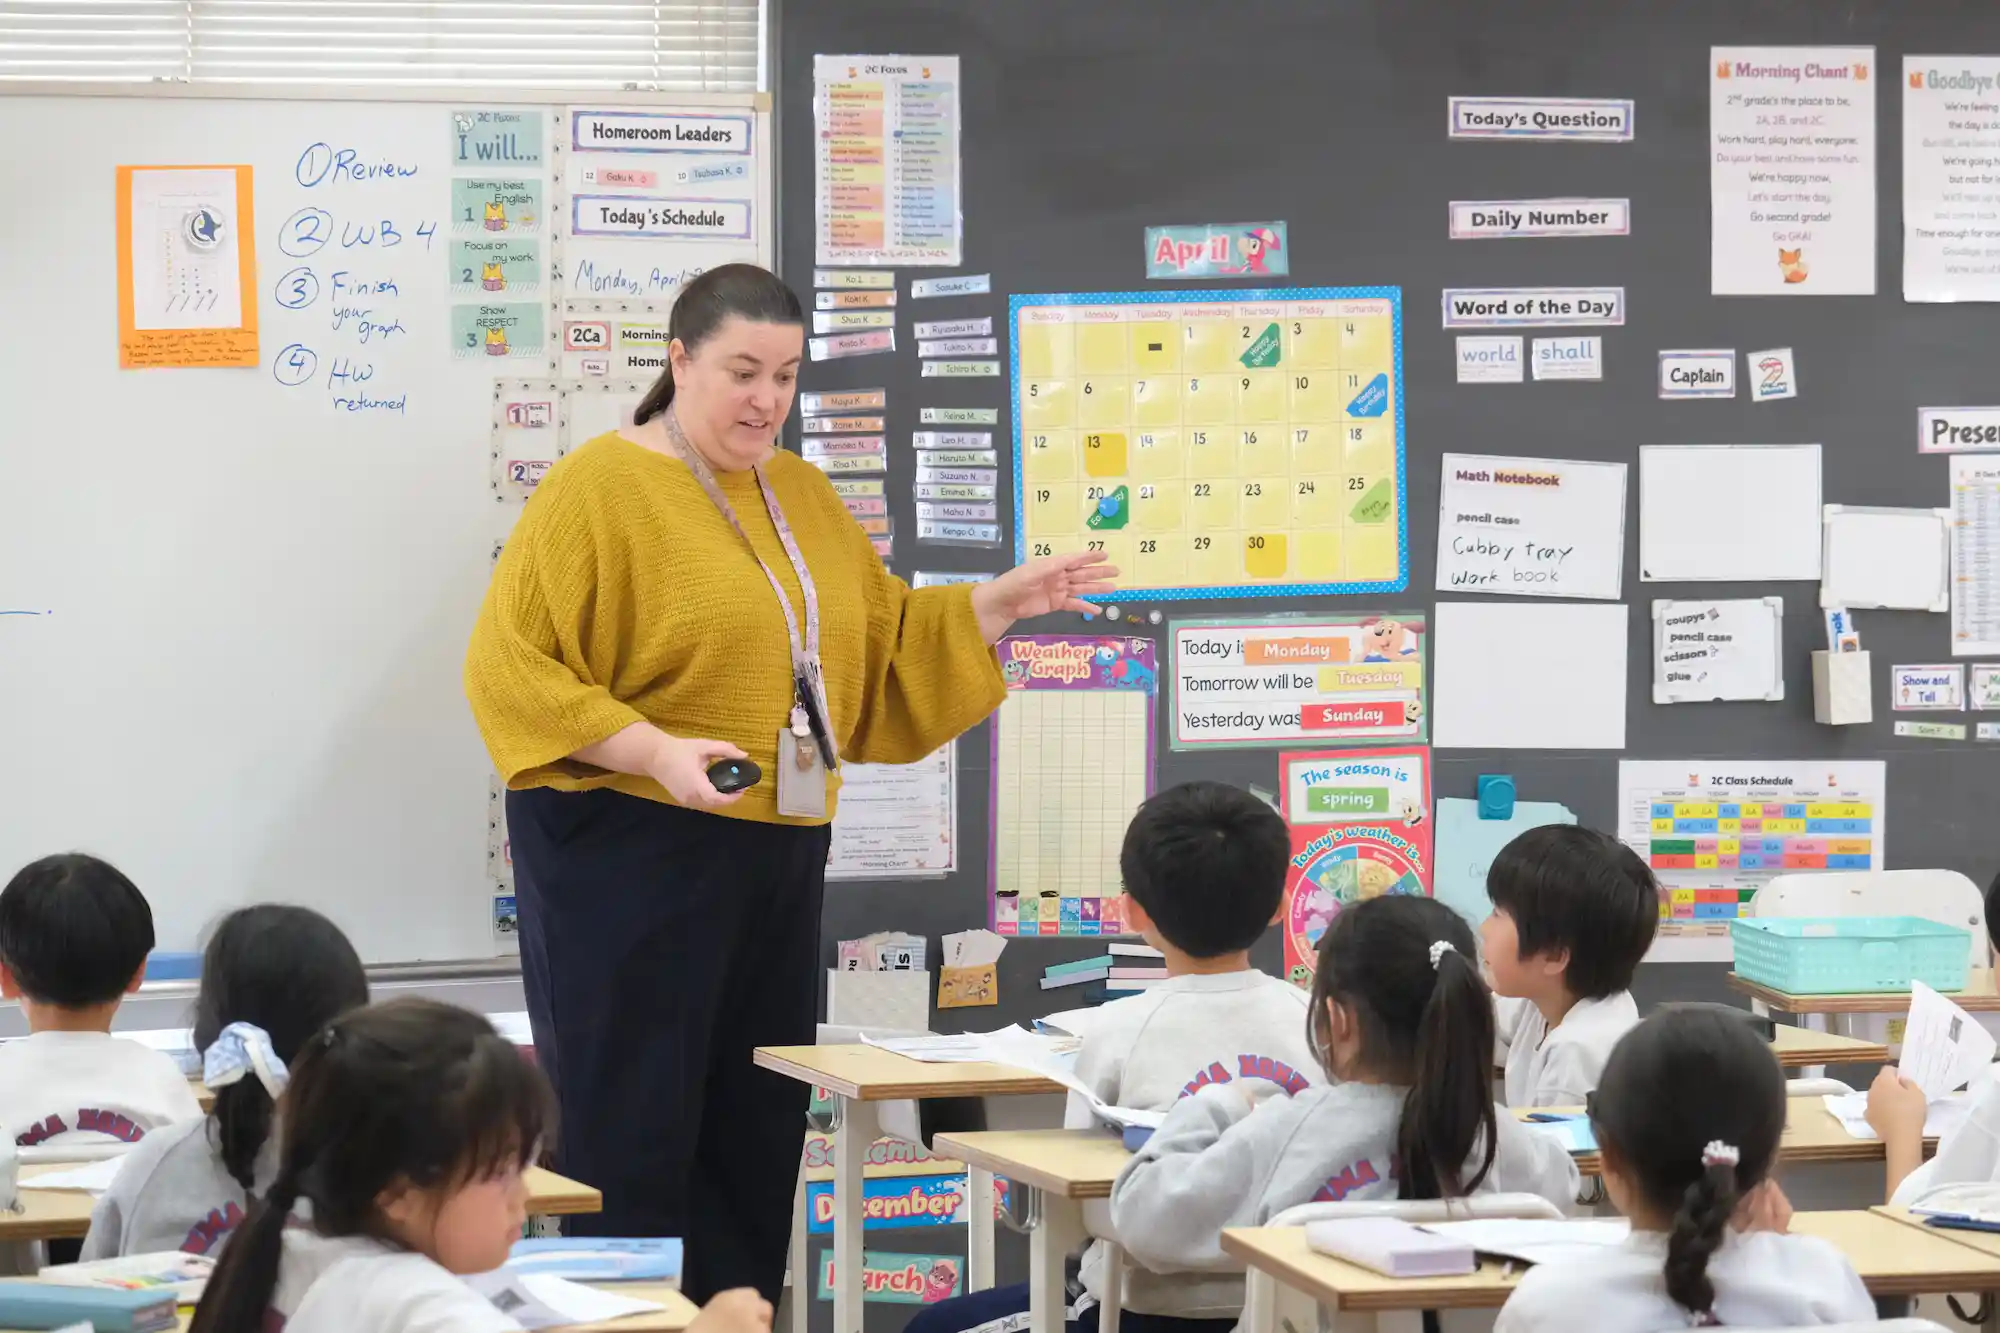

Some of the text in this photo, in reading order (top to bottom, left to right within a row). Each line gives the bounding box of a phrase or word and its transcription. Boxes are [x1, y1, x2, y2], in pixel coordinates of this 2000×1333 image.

[1736, 62, 1849, 84] Morning Chant
[1781, 94, 1797, 106] the
[1798, 94, 1824, 108] place
[1825, 95, 1835, 106] to
[1464, 110, 1622, 131] Today's Question
[592, 122, 732, 142] Homeroom Leaders
[458, 135, 468, 160] I
[333, 148, 418, 185] Review
[466, 180, 524, 192] Use my best
[494, 193, 534, 206] English
[465, 208, 474, 222] 1
[662, 208, 726, 226] Schedule
[1471, 209, 1610, 230] Daily Number
[341, 220, 402, 249] WB
[416, 222, 438, 250] 4
[464, 242, 494, 250] Focus
[1154, 236, 1230, 271] April
[492, 253, 534, 265] my work
[462, 269, 474, 282] 2
[574, 259, 686, 296] Monday, April
[331, 271, 400, 302] Finish
[480, 306, 506, 316] Show
[1454, 298, 1615, 318] Word of the Day
[332, 306, 373, 331] your
[476, 318, 518, 328] RESPECT
[358, 320, 406, 344] graph
[466, 333, 478, 347] 3
[573, 328, 600, 344] 2Ca
[622, 329, 670, 342] Morning
[1242, 326, 1251, 338] 2
[1294, 322, 1302, 335] 3
[1346, 322, 1354, 334] 4
[1462, 340, 1594, 362] world shall
[328, 358, 373, 390] HW
[1670, 356, 1788, 397] Captain 2
[1030, 375, 1358, 398] 5 6 7 8 9 10 11
[332, 391, 406, 415] returned
[512, 408, 520, 424] 1
[1033, 428, 1362, 449] 12 13 14 15 16 17 18
[1932, 418, 2000, 446] Prese
[514, 464, 525, 482] 2
[1456, 470, 1560, 487] Math Notebook
[1036, 478, 1364, 504] 19 20 21 22 23 24 25
[1456, 511, 1520, 525] pencil case
[1034, 536, 1264, 557] 26 27 28 29 30
[1453, 536, 1574, 565] Cubby tray
[1513, 566, 1560, 584] book
[1666, 612, 1706, 627] coupys
[1670, 631, 1733, 646] pencil case
[1012, 642, 1095, 661] Weather
[1182, 638, 1232, 660] Today
[1263, 642, 1331, 661] Monday
[1664, 648, 1708, 664] scissors
[1032, 660, 1089, 682] Graph
[1182, 670, 1404, 692] Tomorrow will be Tuesday
[1667, 671, 1692, 684] glue
[1902, 674, 1950, 686] Show and
[1918, 691, 1936, 703] Tell
[1183, 707, 1384, 731] Yesterday was Sunday
[1300, 764, 1409, 788] The season is
[1711, 776, 1794, 786] 2C Class Schedule
[1322, 792, 1375, 808] spring
[1292, 828, 1343, 869] Today's
[1346, 826, 1406, 849] weather
